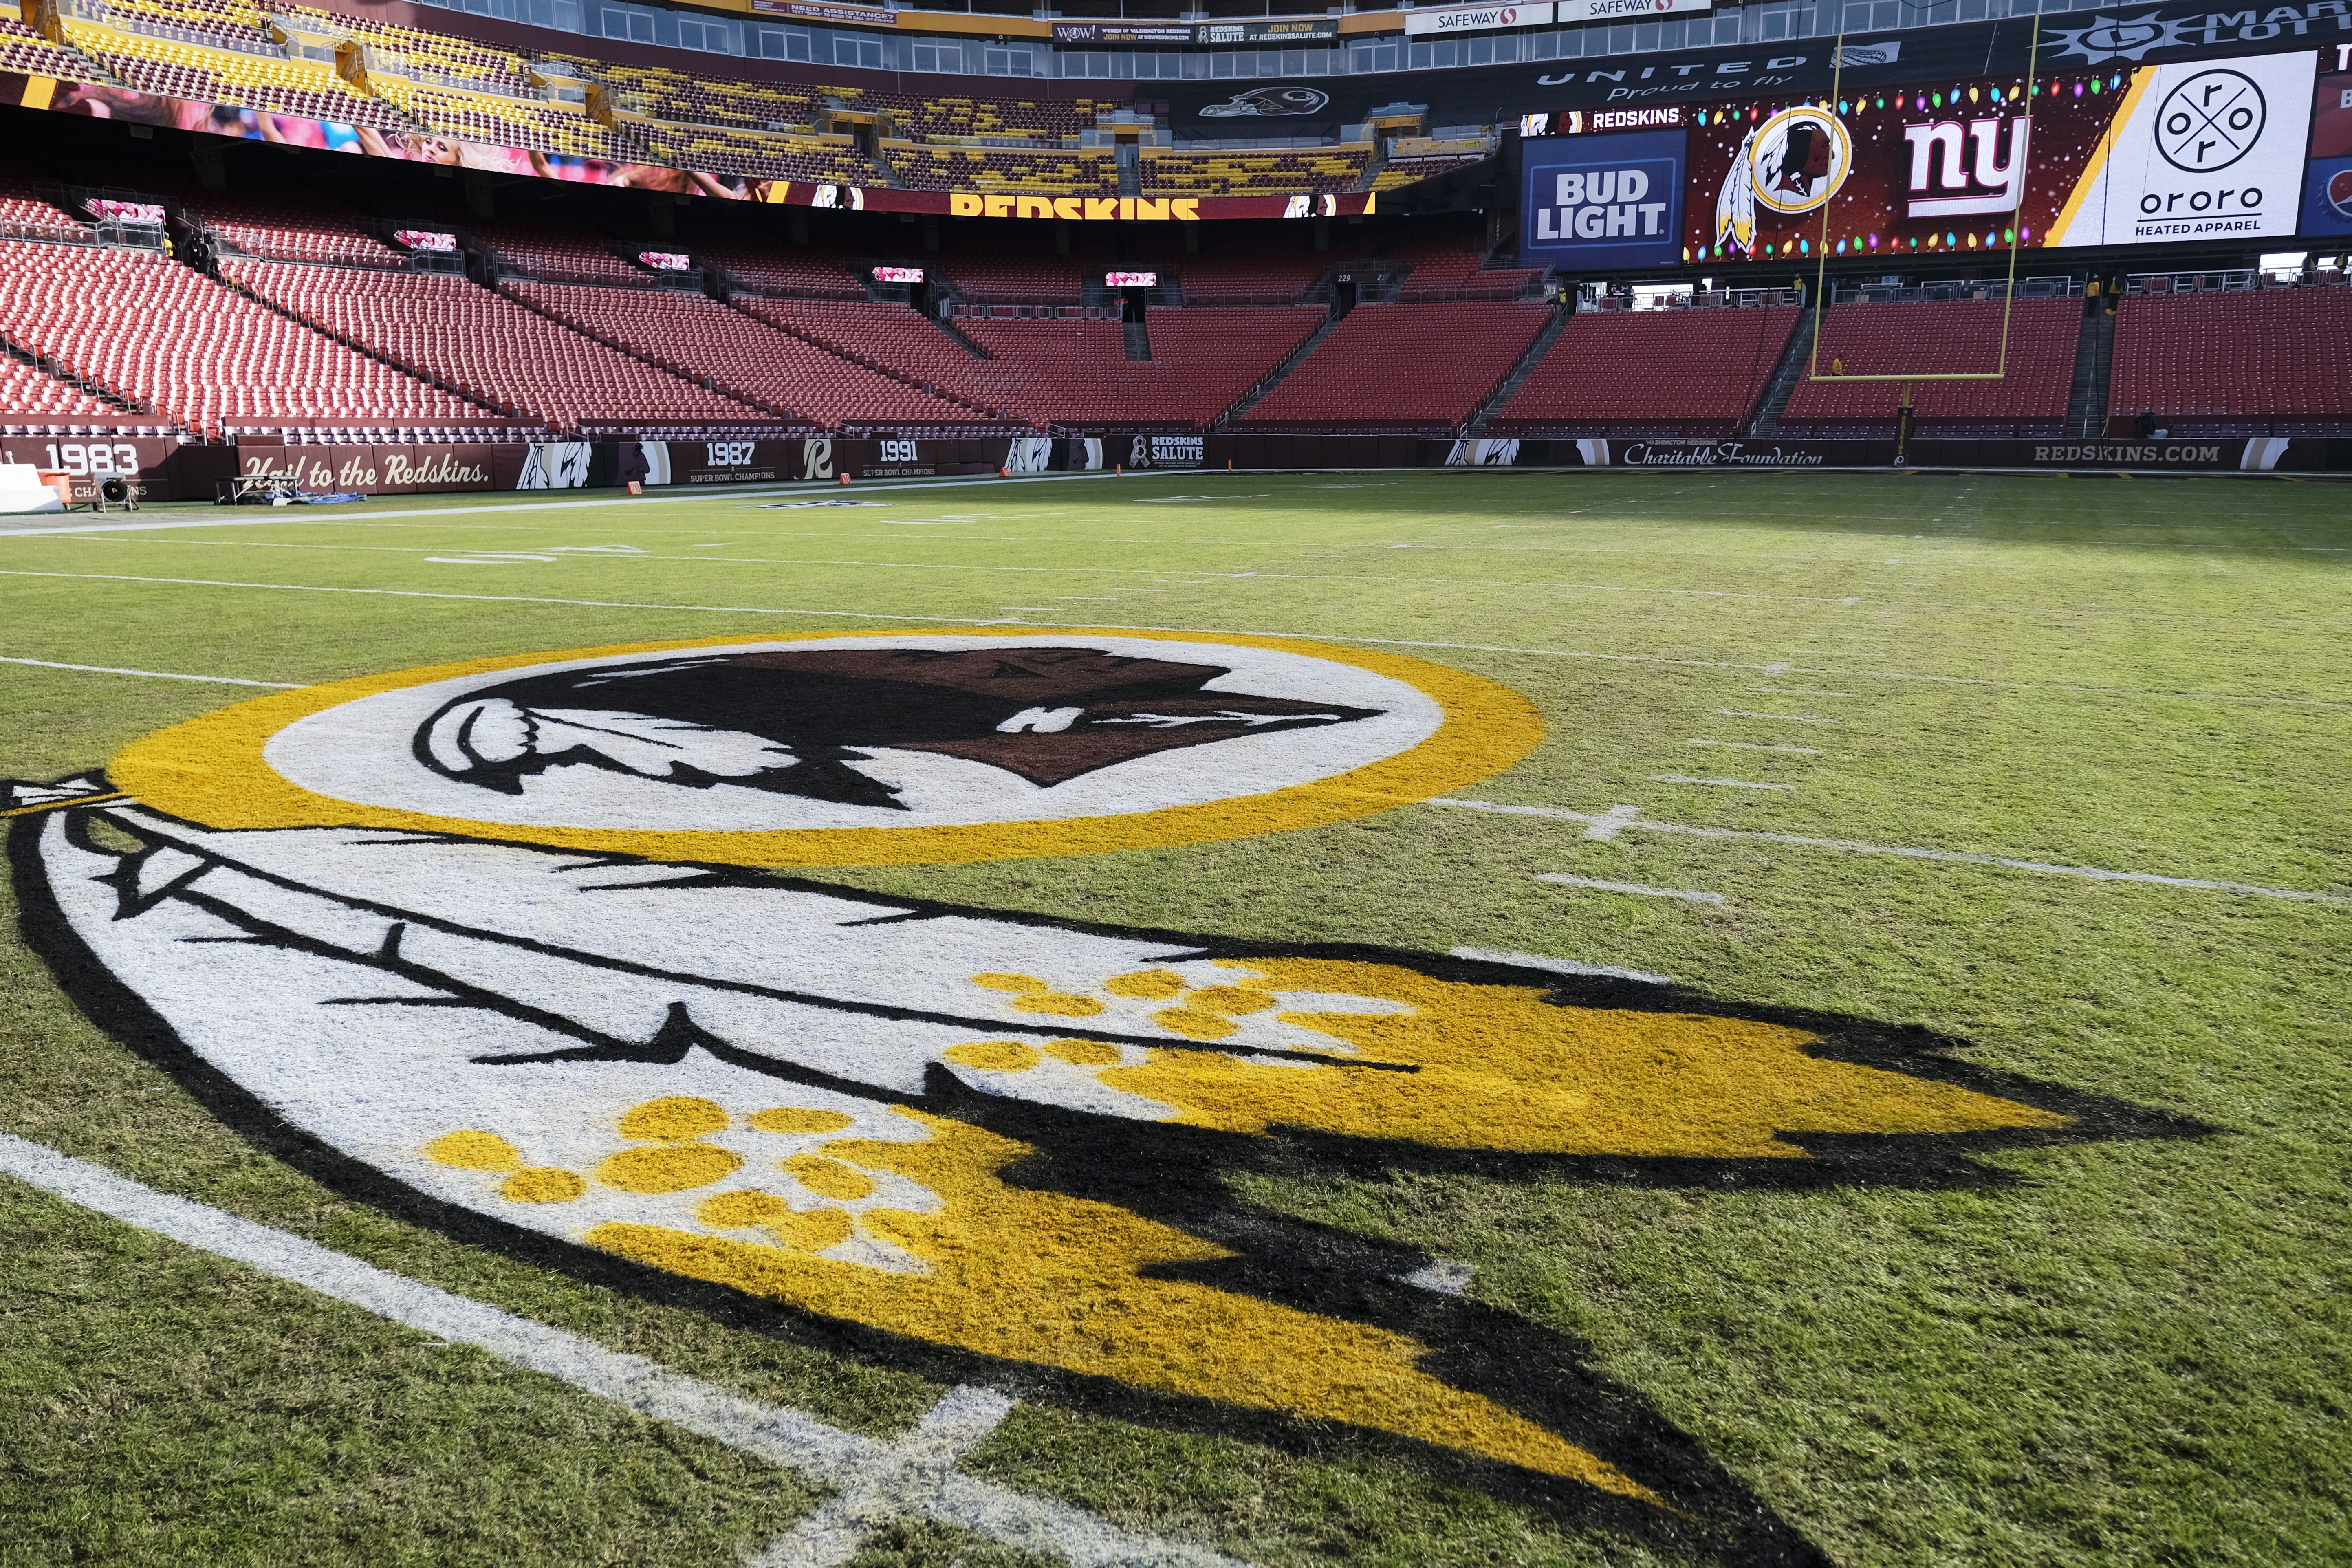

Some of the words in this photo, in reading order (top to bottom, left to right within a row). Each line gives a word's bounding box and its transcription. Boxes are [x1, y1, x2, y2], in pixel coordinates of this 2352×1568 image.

[823, 8, 894, 20] ASSISTANCE?
[1590, 0, 1652, 15] SAFEWAY
[2206, 0, 2352, 27] MAR
[1268, 24, 1289, 33] JOIN
[1291, 24, 1313, 32] NOW
[1438, 11, 1498, 28] SAFEWAY
[1057, 25, 1096, 40] WOW!
[1210, 32, 1244, 42] SALUTE
[1259, 32, 1332, 40] REDSKINSSALUTE.COM
[1537, 57, 1807, 85] UNITED
[1606, 81, 1700, 101] Proud
[1710, 81, 1741, 89] to
[1753, 75, 1794, 86] fly
[864, 116, 876, 124] 328
[1593, 108, 1680, 129] REDSKINS
[1556, 170, 1649, 205] BUD
[950, 193, 1200, 220] REDSKINS
[2140, 187, 2263, 214] ororo
[1537, 203, 1666, 239] LIGHT
[2135, 225, 2191, 236] HEATED
[2194, 220, 2261, 233] APPAREL
[880, 440, 918, 461] 1991
[1152, 437, 1204, 445] REDSKINS
[46, 444, 139, 476] 1983
[707, 442, 755, 466] 1987
[1152, 446, 1204, 460] SALUTE
[1624, 443, 1717, 465] Charitable
[1717, 443, 1823, 465] Foundation
[2034, 445, 2220, 462] REDSKINS.COM
[309, 461, 335, 487] to
[339, 456, 378, 486] the
[384, 453, 489, 485] Redskins.
[735, 472, 775, 480] CHAMPIONS
